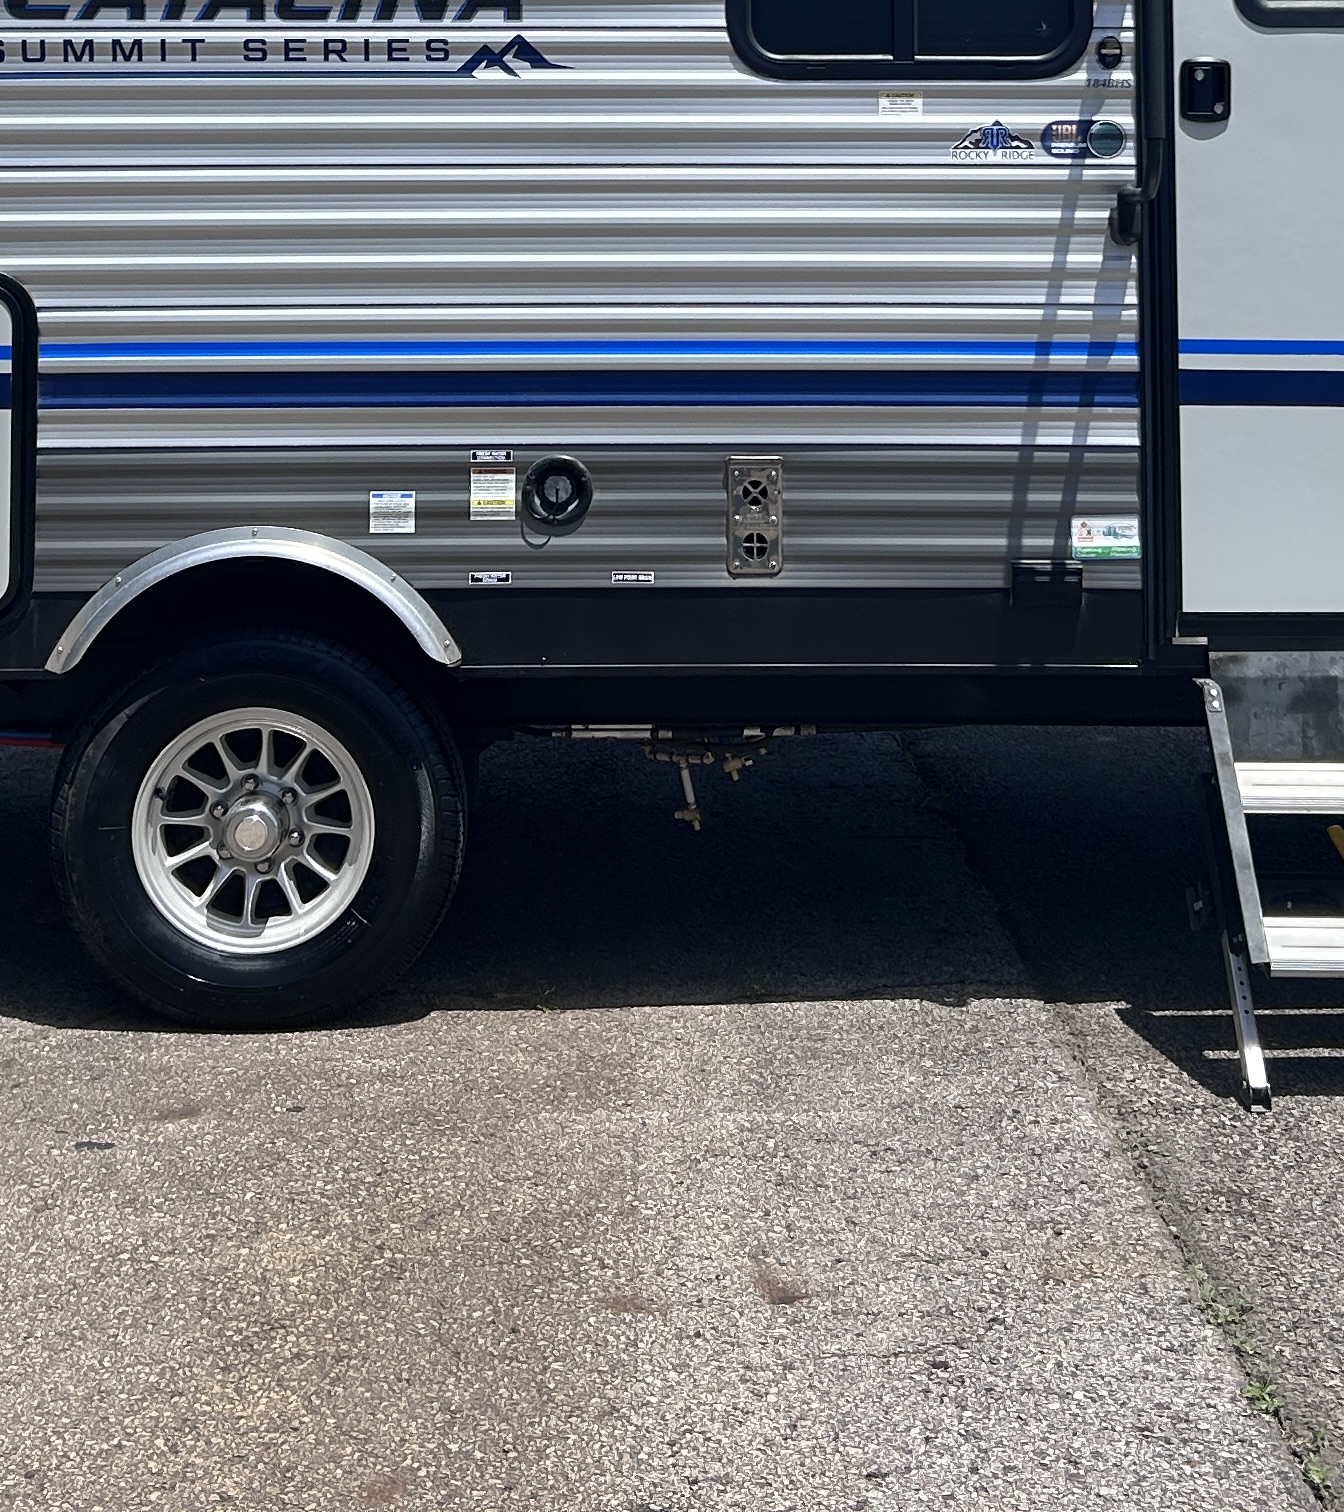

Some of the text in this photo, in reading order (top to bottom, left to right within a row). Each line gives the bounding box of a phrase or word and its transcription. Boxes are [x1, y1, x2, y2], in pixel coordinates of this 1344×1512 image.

[242, 37, 452, 63] SERIES
[951, 150, 1035, 160] ROCKY RIDGE
